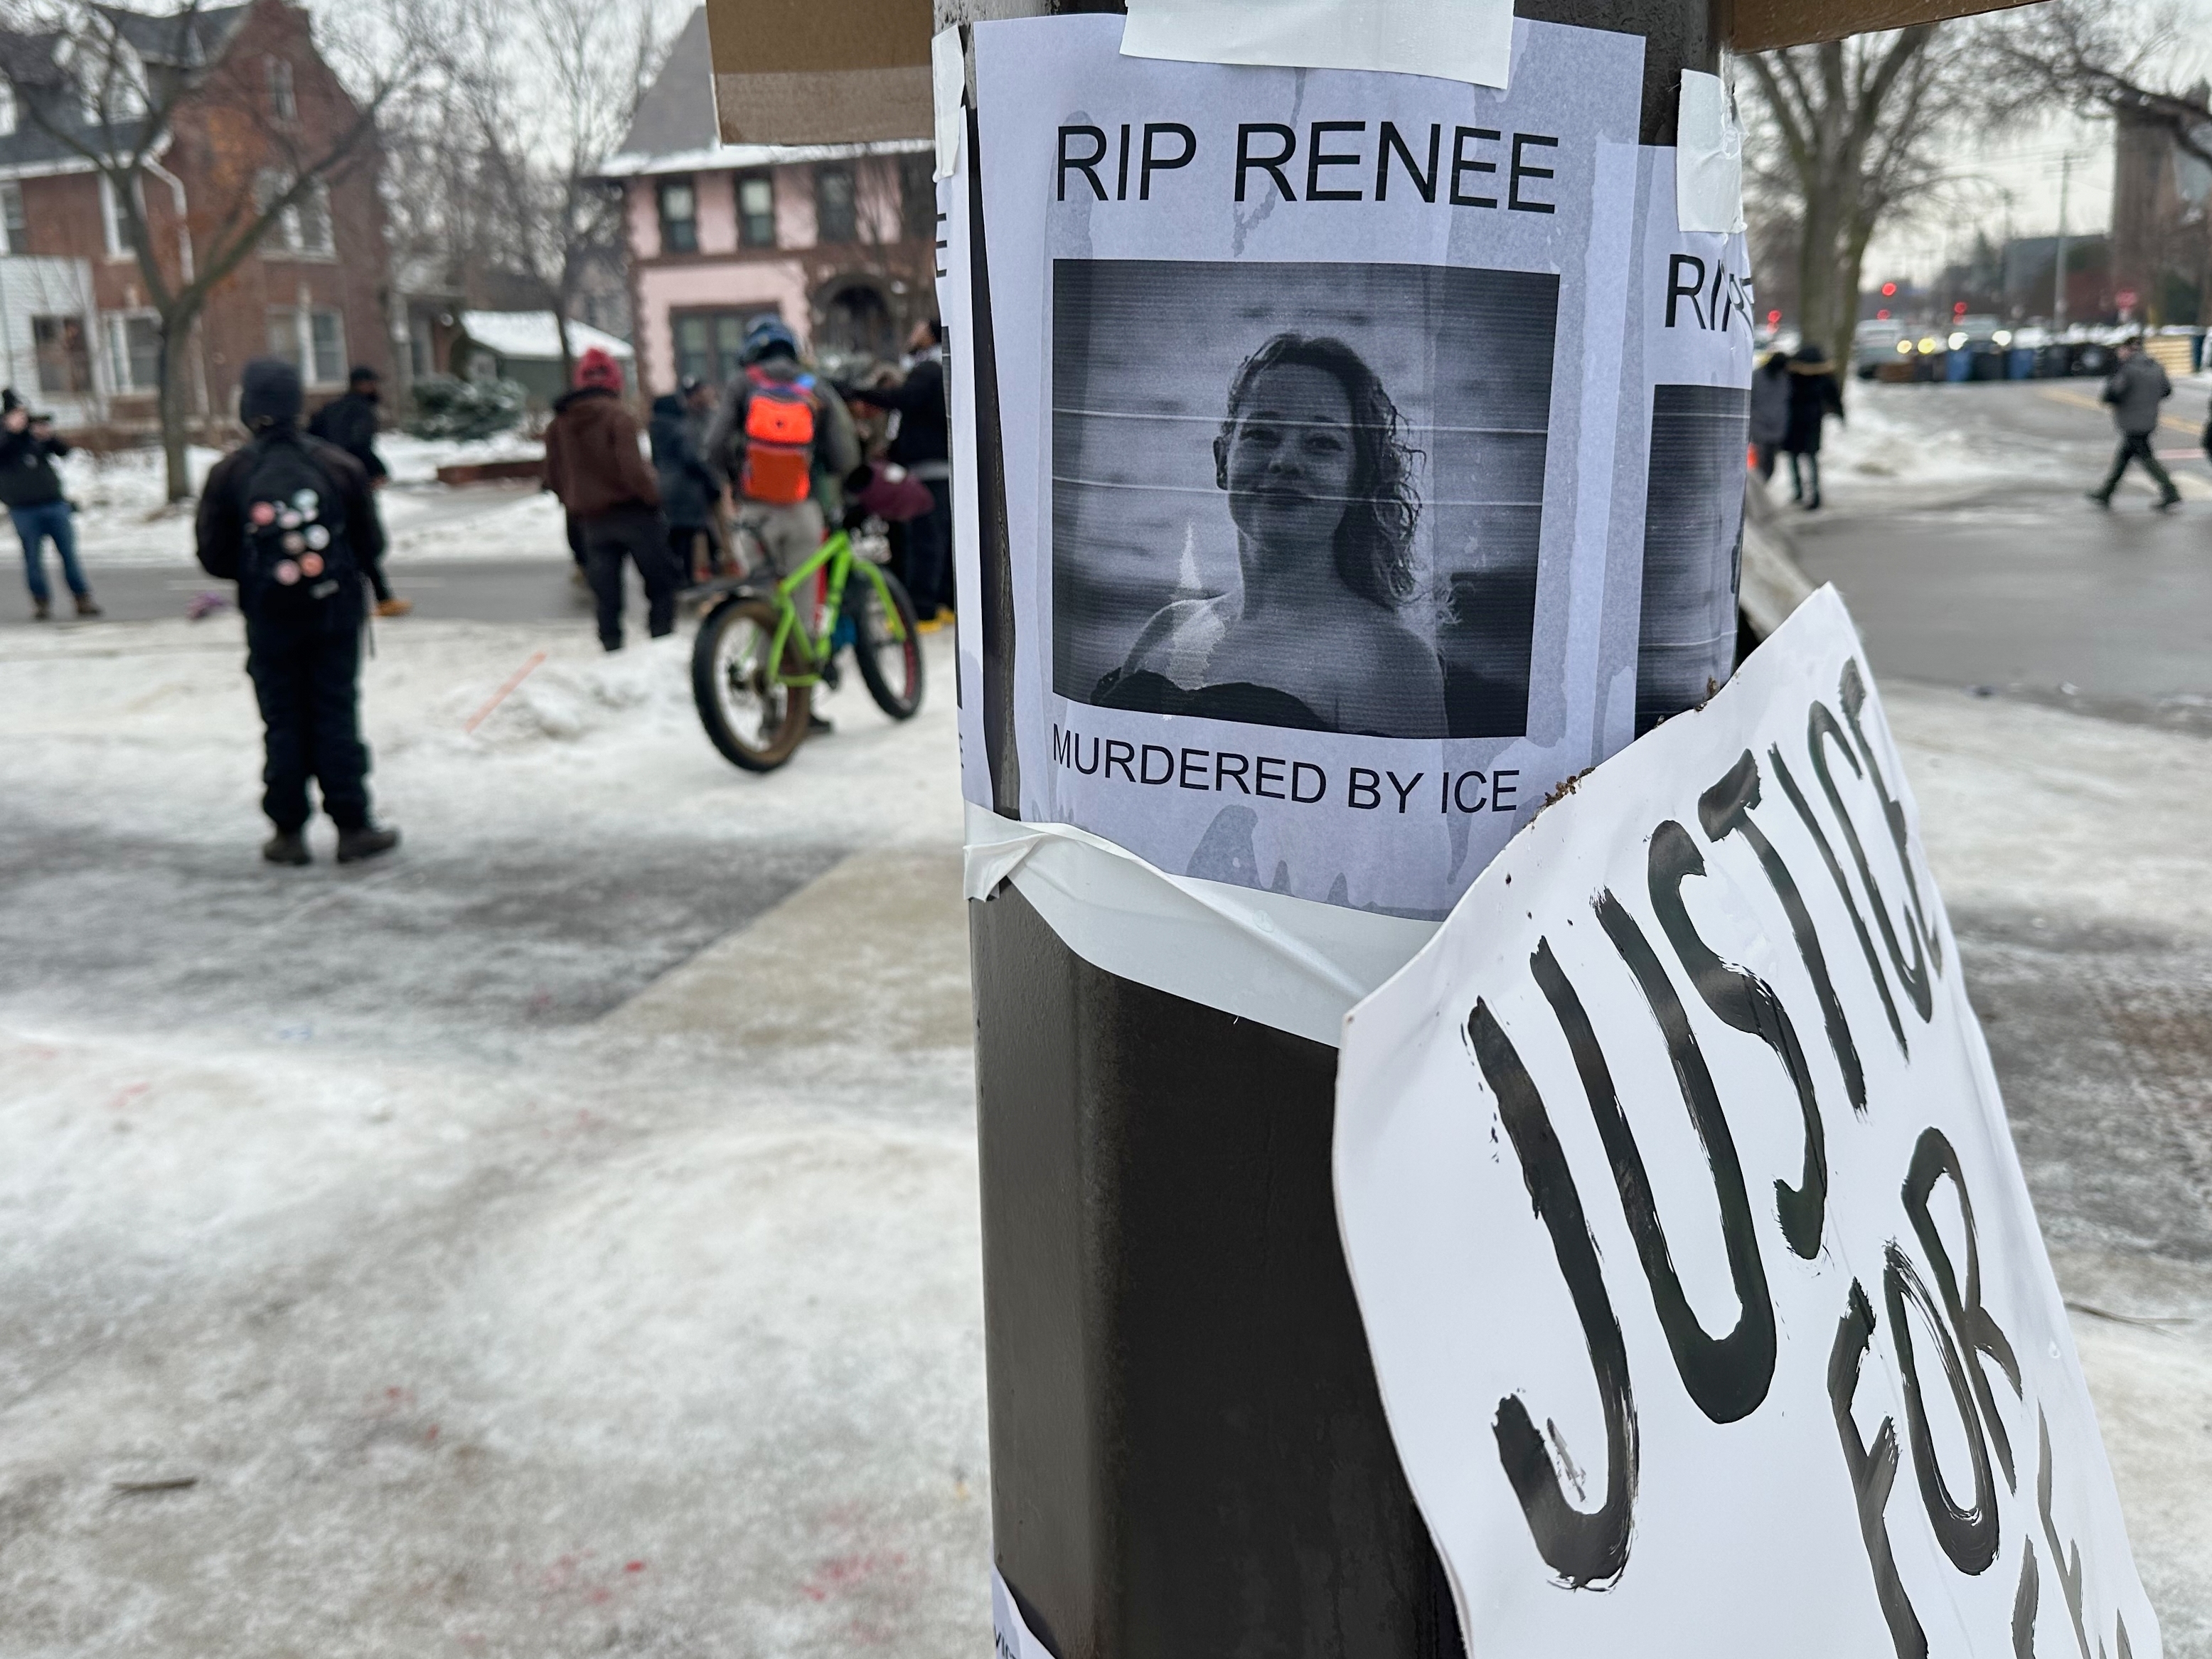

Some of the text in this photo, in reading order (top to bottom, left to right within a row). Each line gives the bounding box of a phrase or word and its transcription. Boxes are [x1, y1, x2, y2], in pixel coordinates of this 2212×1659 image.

[1057, 120, 1559, 214] RIP RENEE
[1052, 722, 1520, 814] MURDERED BY ICE
[1460, 656, 1943, 1593] JUSTICE
[1827, 1126, 2023, 1659] FOR
